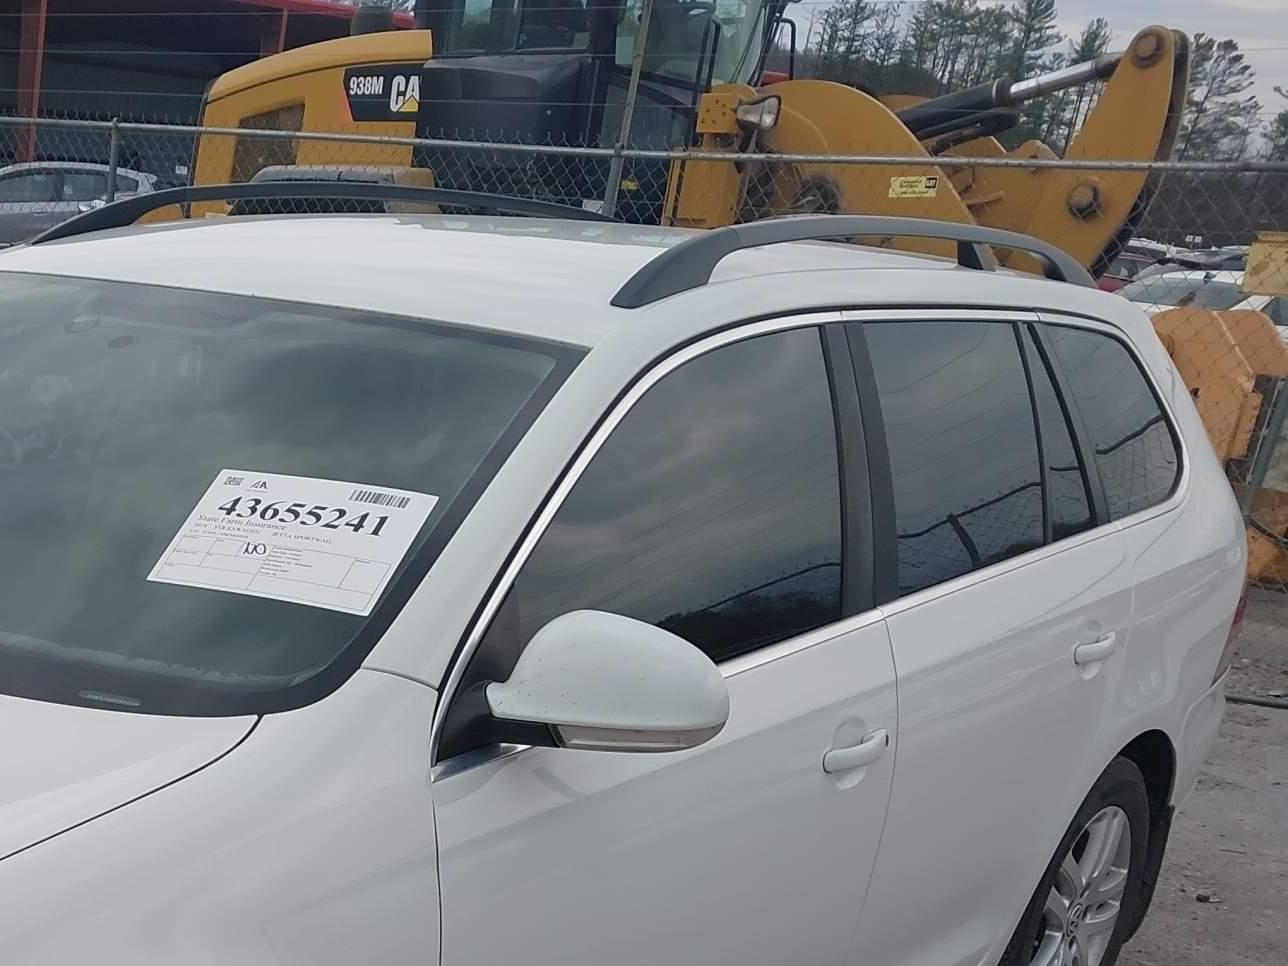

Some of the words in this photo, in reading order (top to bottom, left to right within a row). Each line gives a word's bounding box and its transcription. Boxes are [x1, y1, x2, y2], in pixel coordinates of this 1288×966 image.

[349, 76, 384, 95] 938M
[390, 75, 423, 112] CA
[197, 515, 219, 523] State
[221, 516, 243, 526] Farm
[245, 519, 287, 531] Insurance
[218, 496, 389, 537] 43655241
